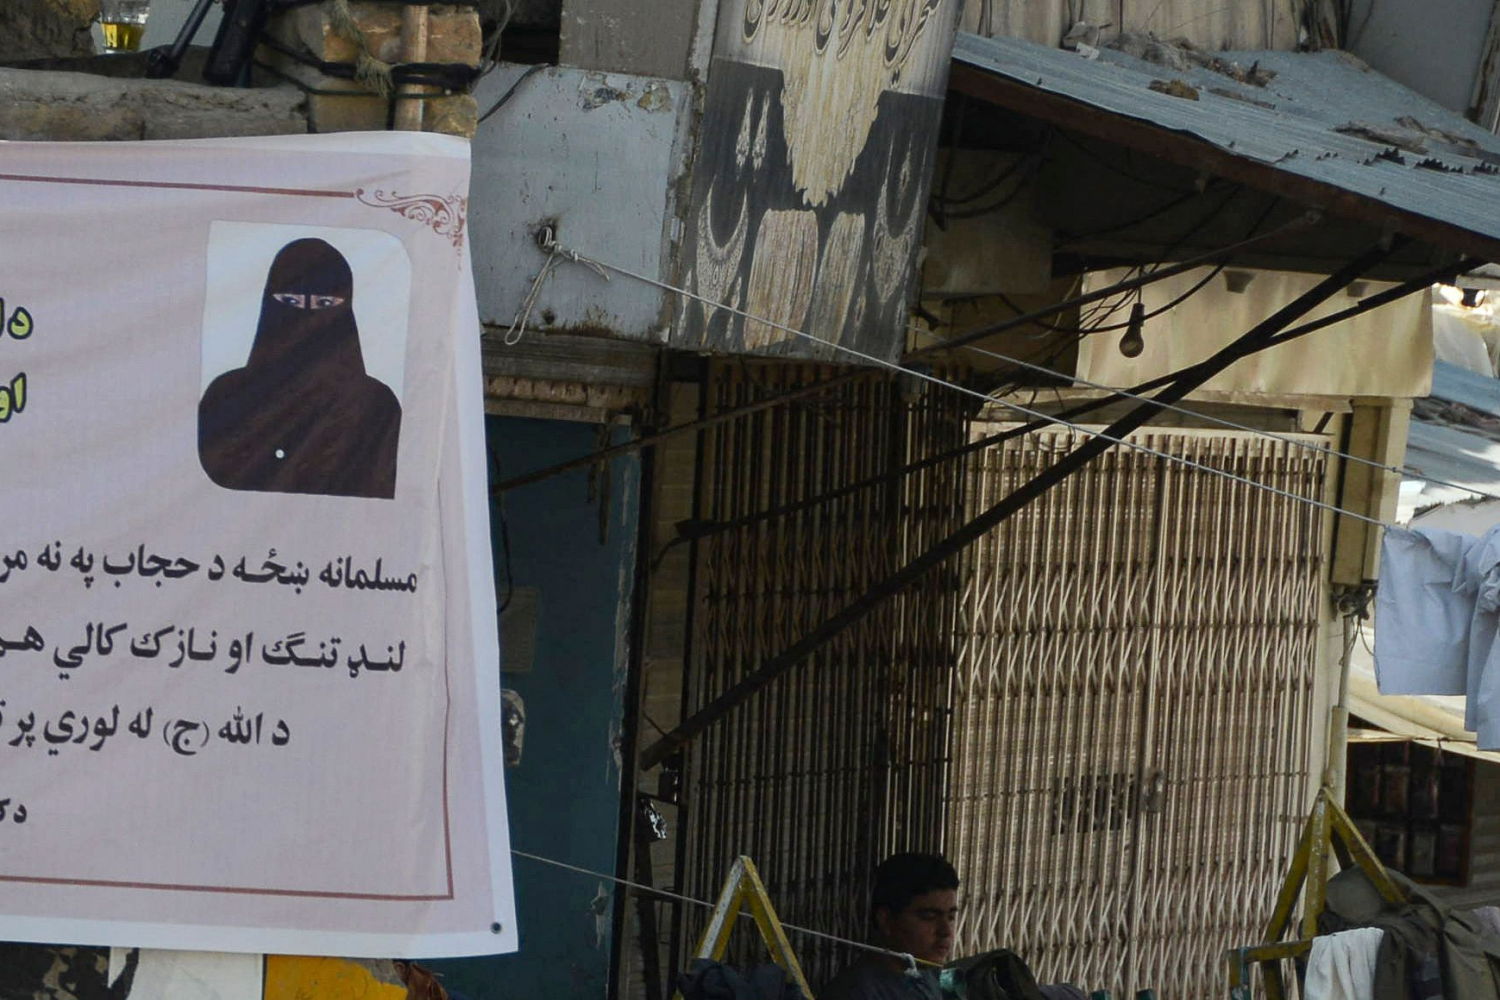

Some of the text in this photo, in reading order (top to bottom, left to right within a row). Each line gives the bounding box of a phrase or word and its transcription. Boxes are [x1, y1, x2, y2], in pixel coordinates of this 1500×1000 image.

[7, 307, 33, 340] د
[36, 540, 62, 572] نه
[69, 546, 95, 589] په
[102, 543, 201, 589] حجاب
[207, 554, 226, 581] د
[318, 555, 418, 594] مسلمانه
[224, 631, 254, 675] او
[347, 640, 406, 679] لنډ
[8, 711, 36, 749] پر
[128, 706, 154, 739] له
[217, 705, 264, 745] الله
[271, 719, 291, 747] د
[13, 804, 28, 824] د
